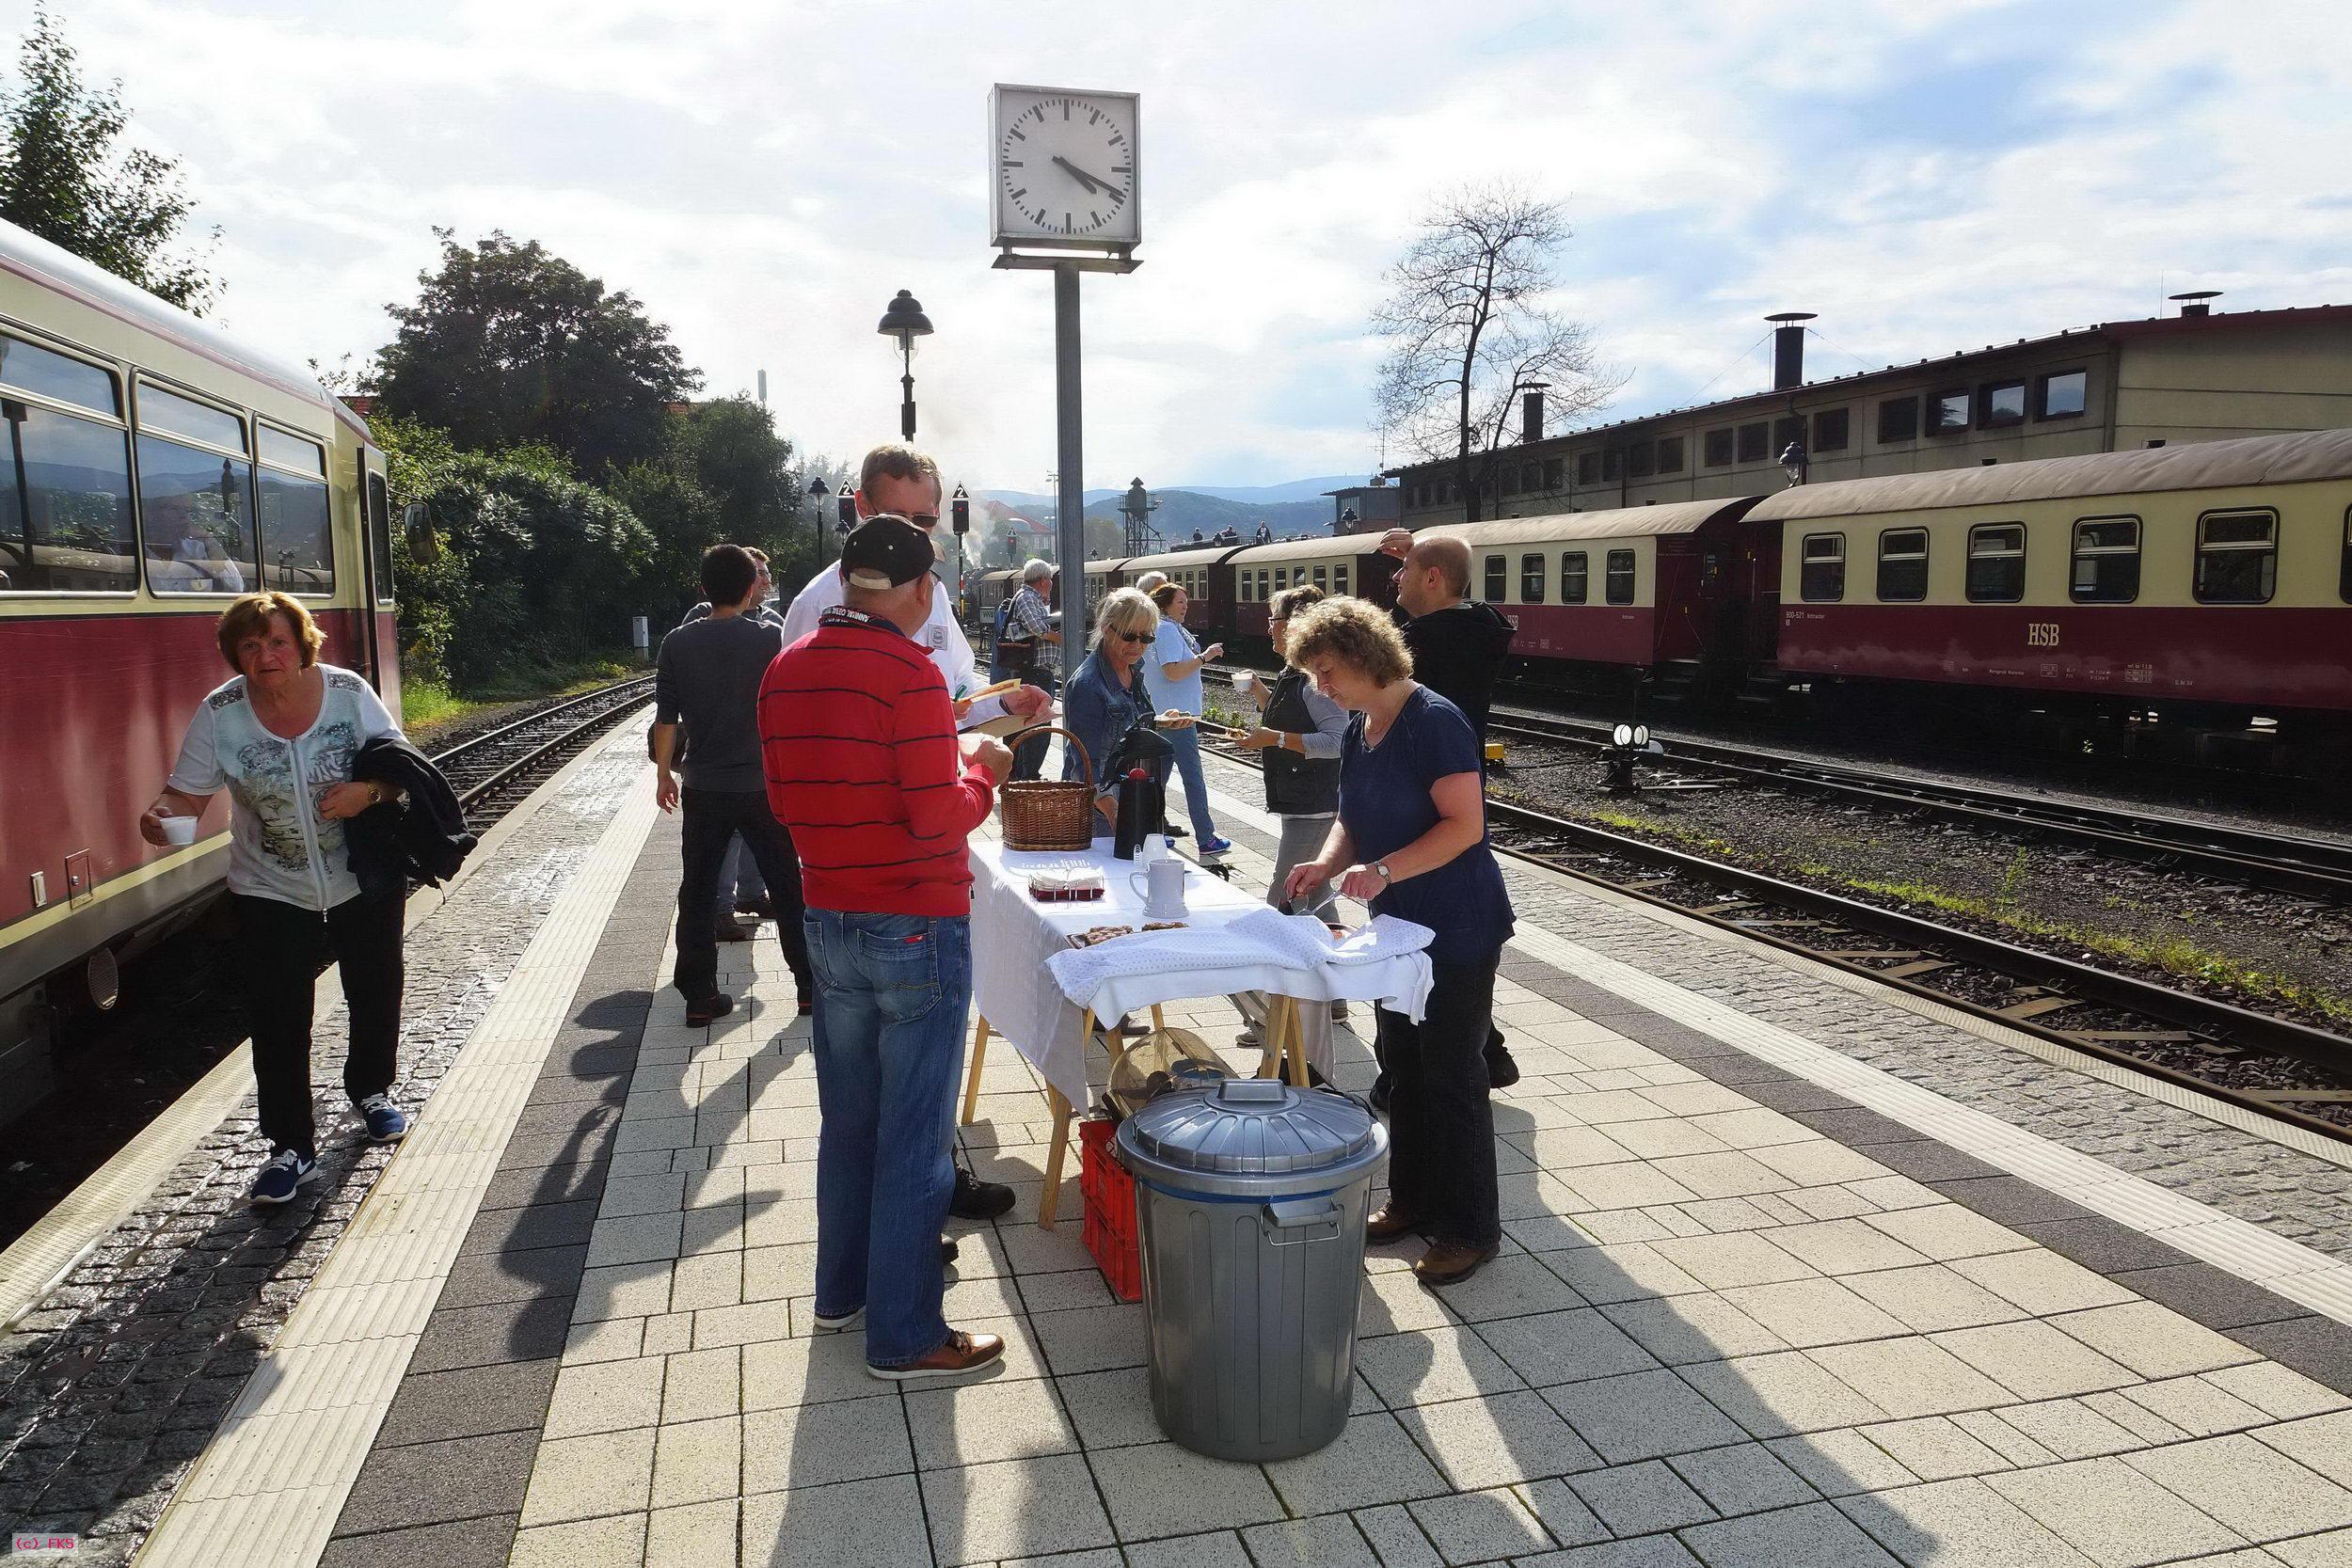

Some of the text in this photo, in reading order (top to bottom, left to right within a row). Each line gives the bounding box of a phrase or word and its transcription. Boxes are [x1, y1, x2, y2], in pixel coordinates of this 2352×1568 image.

[843, 483, 850, 495] 2
[957, 486, 964, 498] 2
[2027, 623, 2059, 646] HSB
